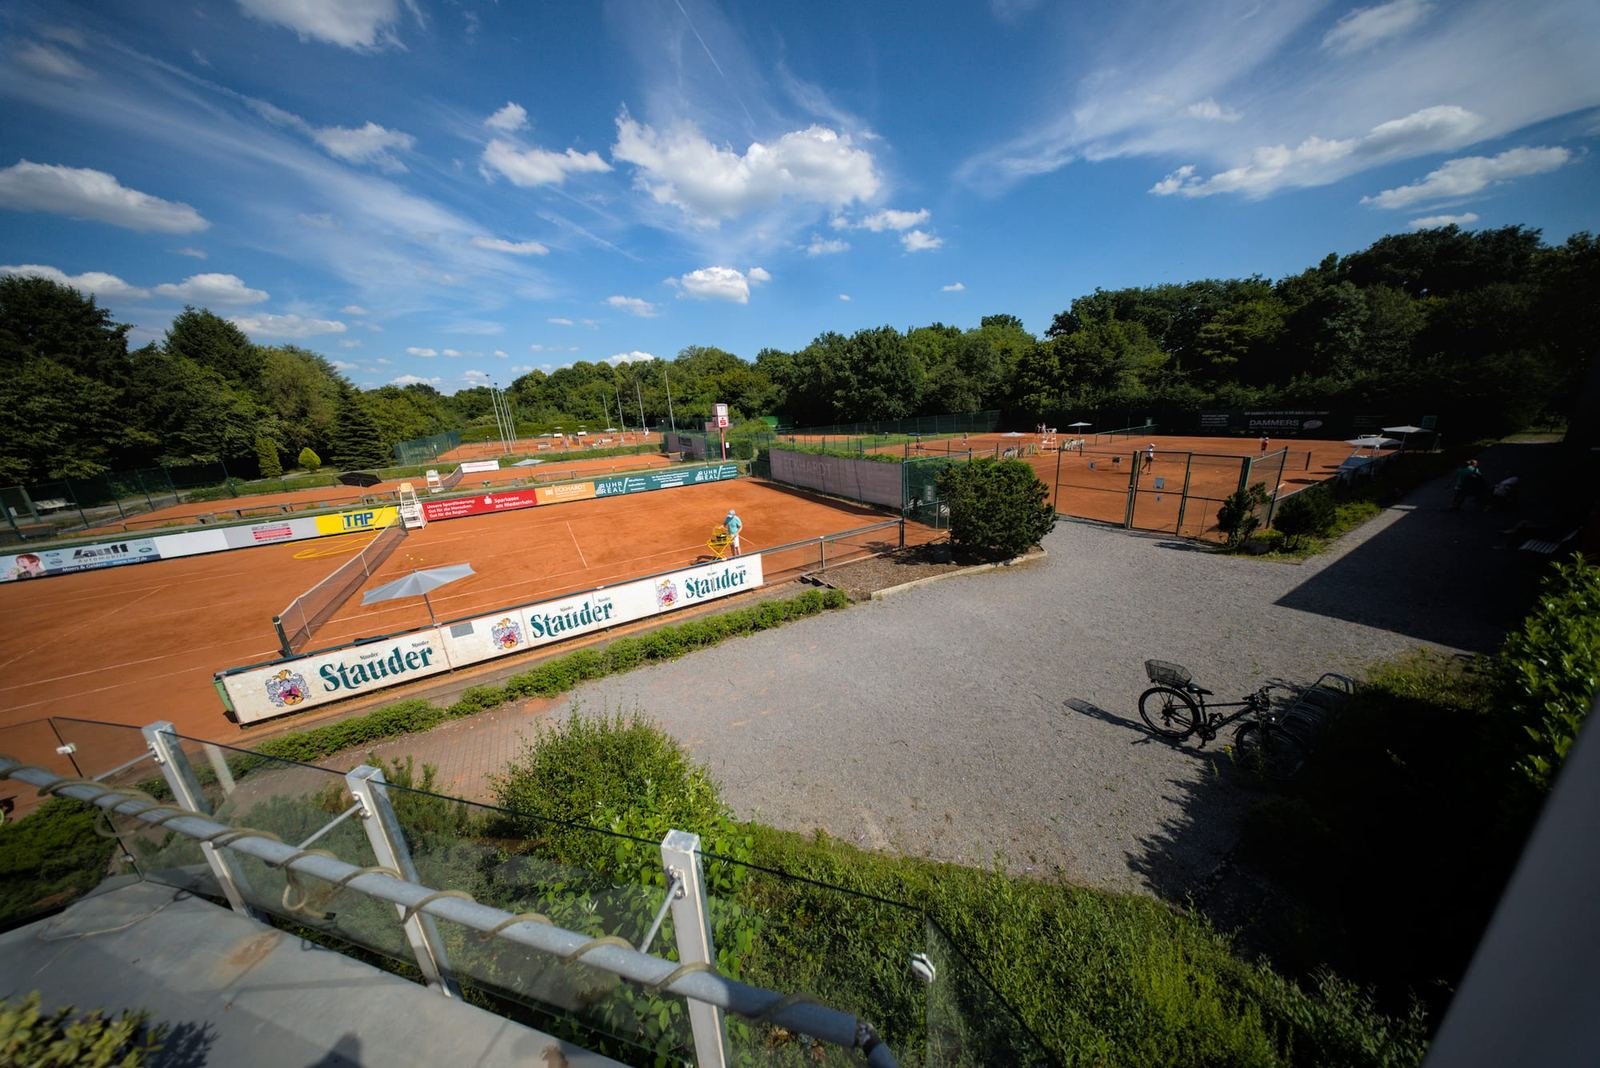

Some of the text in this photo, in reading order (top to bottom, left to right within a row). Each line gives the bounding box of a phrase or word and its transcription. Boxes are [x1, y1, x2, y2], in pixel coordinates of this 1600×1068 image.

[599, 481, 623, 489] RUHR
[700, 473, 718, 481] REAL
[601, 487, 624, 495] REAL
[344, 511, 374, 528] TAP
[684, 567, 747, 599] Stauder
[530, 601, 613, 639] Stauder
[318, 645, 434, 692] Stauder
